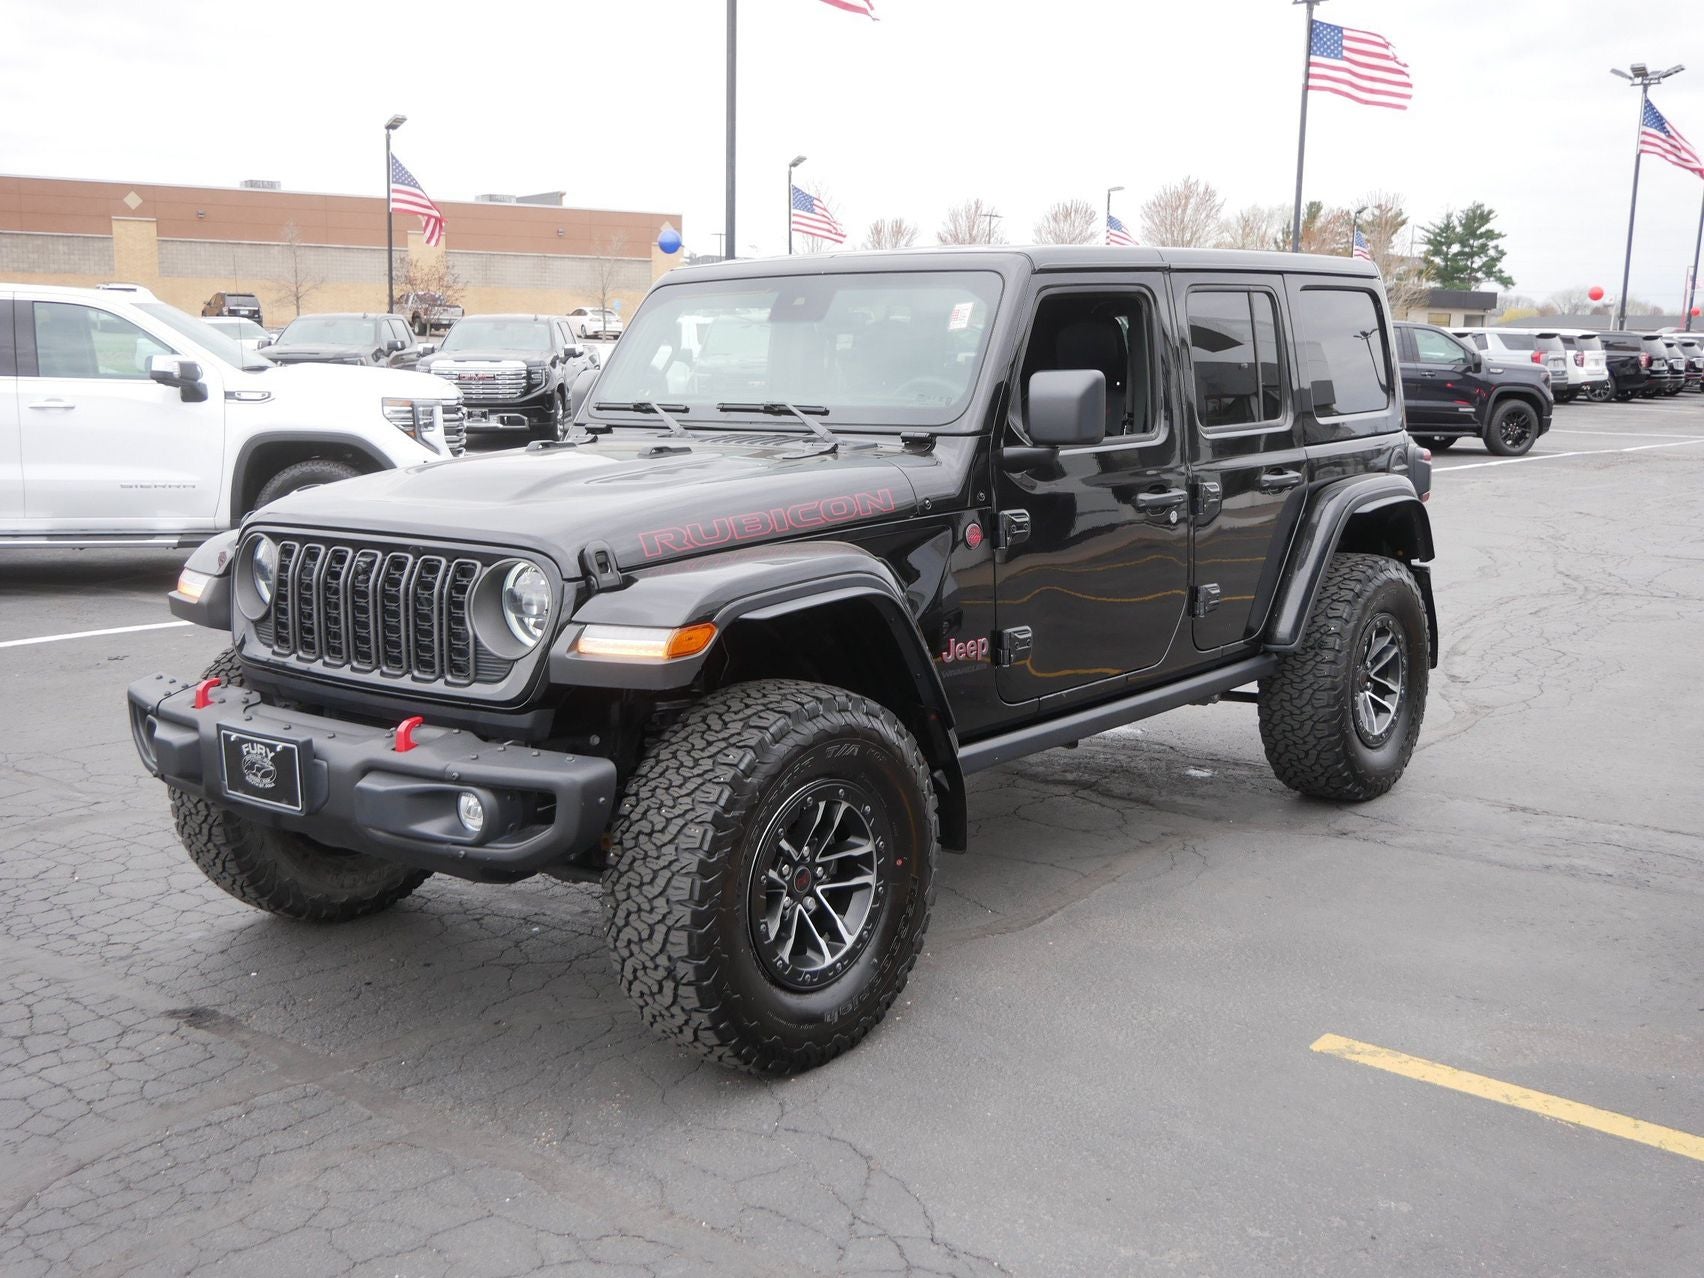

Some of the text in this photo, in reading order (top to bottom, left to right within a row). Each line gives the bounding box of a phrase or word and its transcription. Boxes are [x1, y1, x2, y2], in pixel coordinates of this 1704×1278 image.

[638, 488, 897, 558] RUBICON
[941, 637, 989, 663] Jeep
[241, 742, 275, 761] FURY
